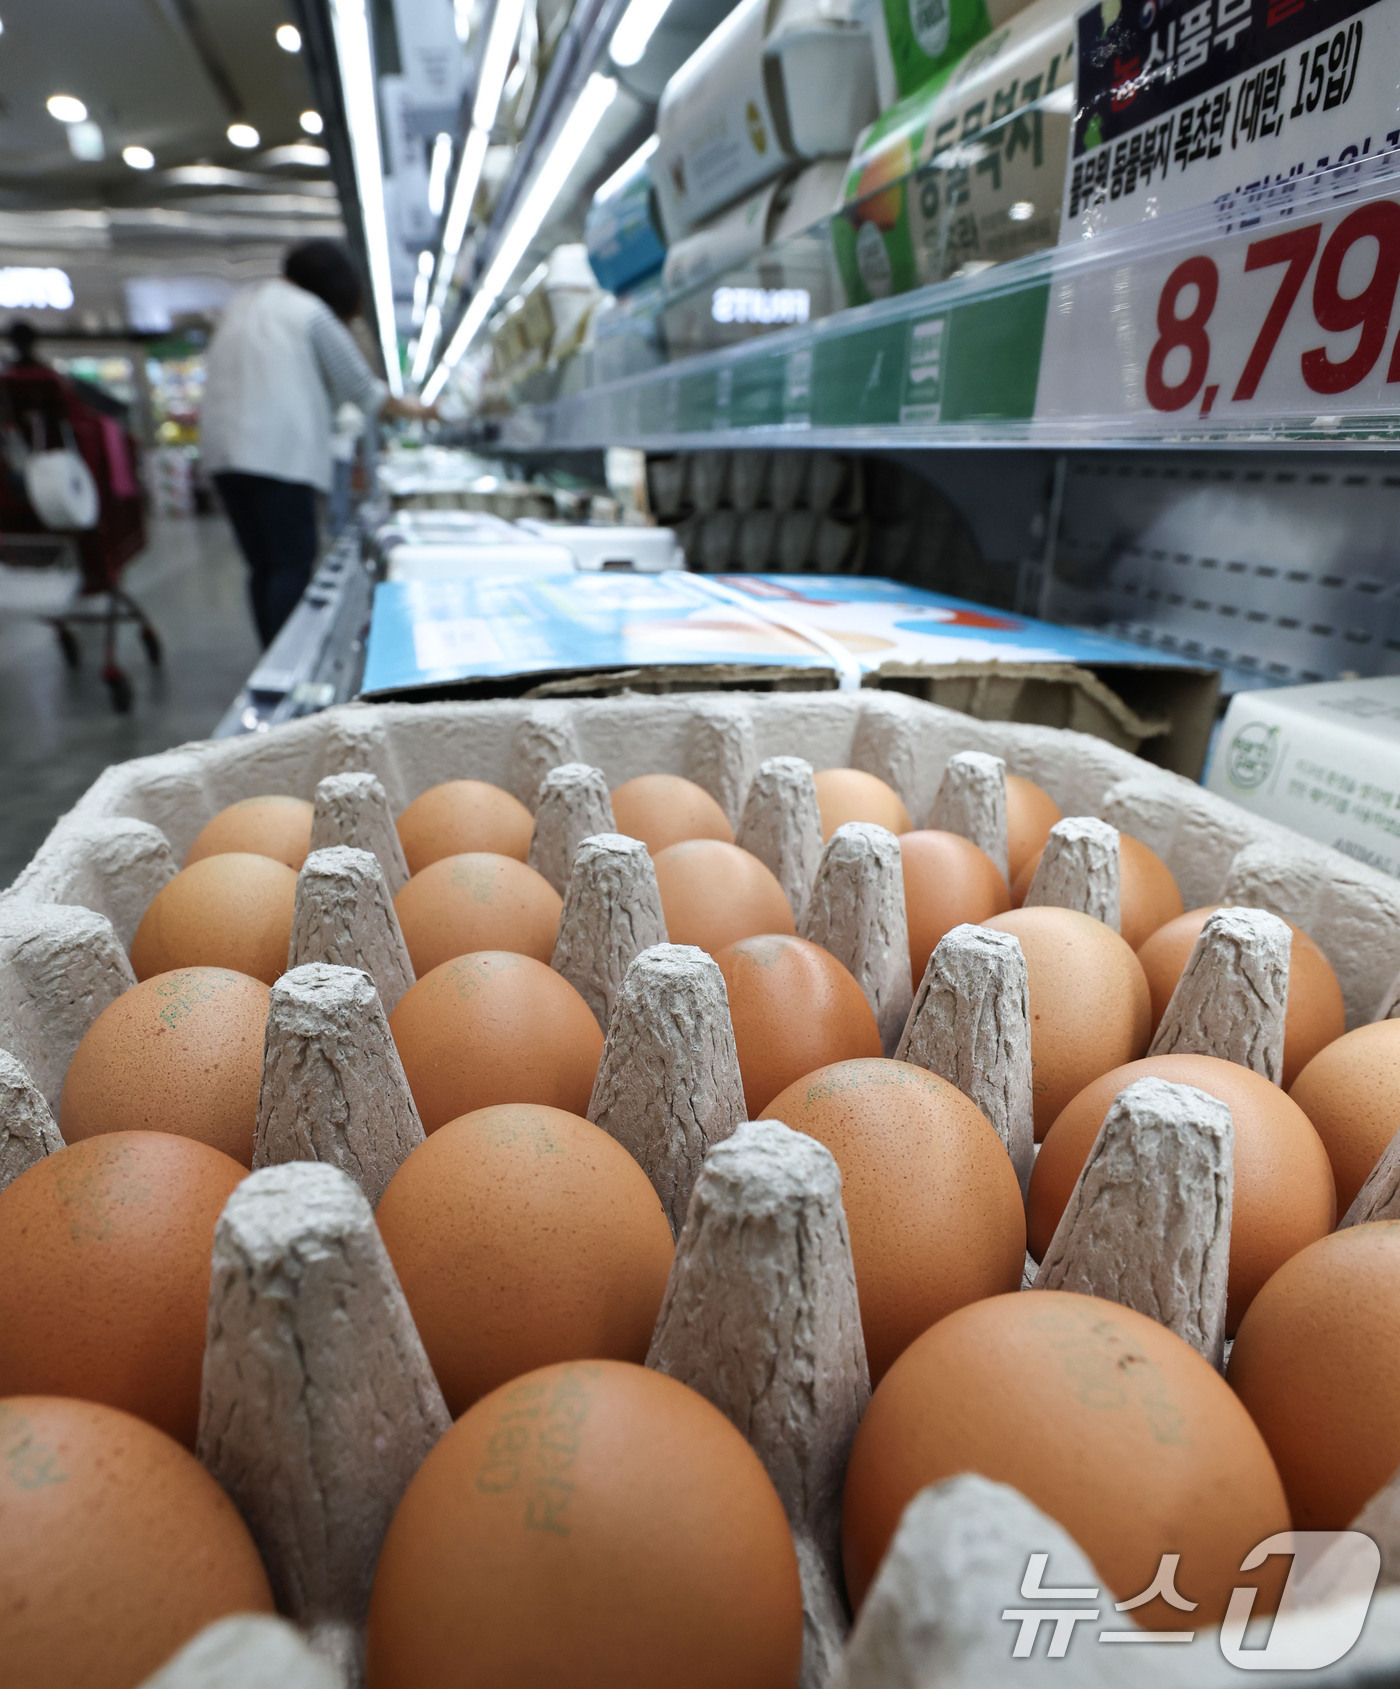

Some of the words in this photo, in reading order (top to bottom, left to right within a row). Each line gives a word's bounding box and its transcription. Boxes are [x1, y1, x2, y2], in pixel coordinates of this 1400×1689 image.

[1110, 115, 1174, 201] 동물복지
[1174, 86, 1232, 171] 목초란
[1290, 20, 1363, 118] 15입)
[1145, 199, 1400, 420] 8,79
